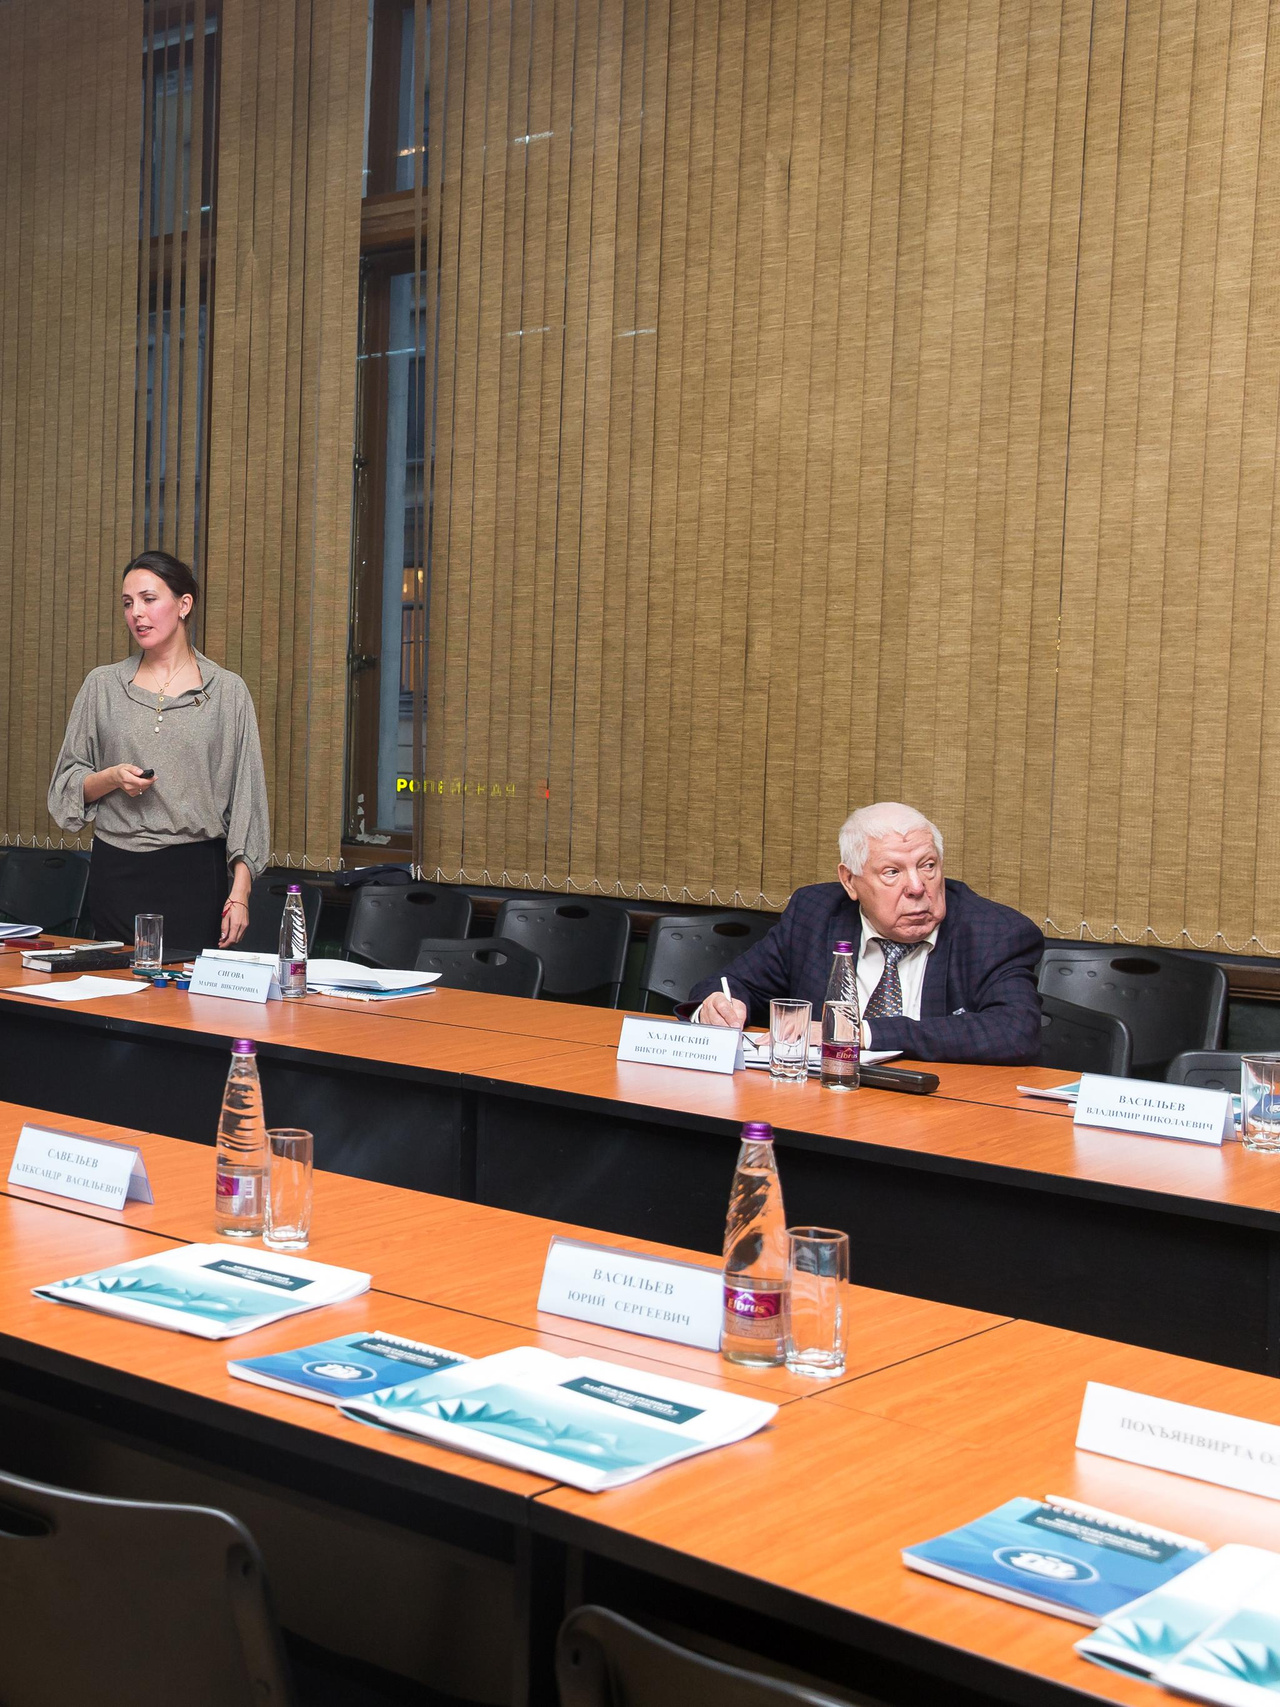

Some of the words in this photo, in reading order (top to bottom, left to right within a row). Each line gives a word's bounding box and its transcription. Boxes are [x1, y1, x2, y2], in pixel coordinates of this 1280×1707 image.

[217, 970, 245, 979] СИГОВА
[647, 1031, 710, 1046] ХАЛАНСКИЙ
[634, 1045, 668, 1056] ВИКТОР
[672, 1050, 718, 1061] ПЕТРОВИЧ
[1118, 1094, 1186, 1112] ВАСИЛЬЕВ
[1086, 1106, 1141, 1121] ВЛАДИМИР
[1142, 1113, 1214, 1131] НИКОЛАЕВИЧ
[47, 1148, 99, 1169] САВЕЛЬЕВ
[15, 1162, 62, 1181] АЛЕКСАНДР
[65, 1175, 124, 1196] ВАСИЛЬЕВИЧ
[592, 1268, 675, 1296] ВАСИЛЬЕВ
[567, 1289, 606, 1308] ЮРИЙ
[614, 1300, 691, 1326] СЕРГЕЕВИЧ
[727, 1297, 765, 1314] Elbrus
[1120, 1417, 1254, 1461] ПОХЪЯНВИРТА
